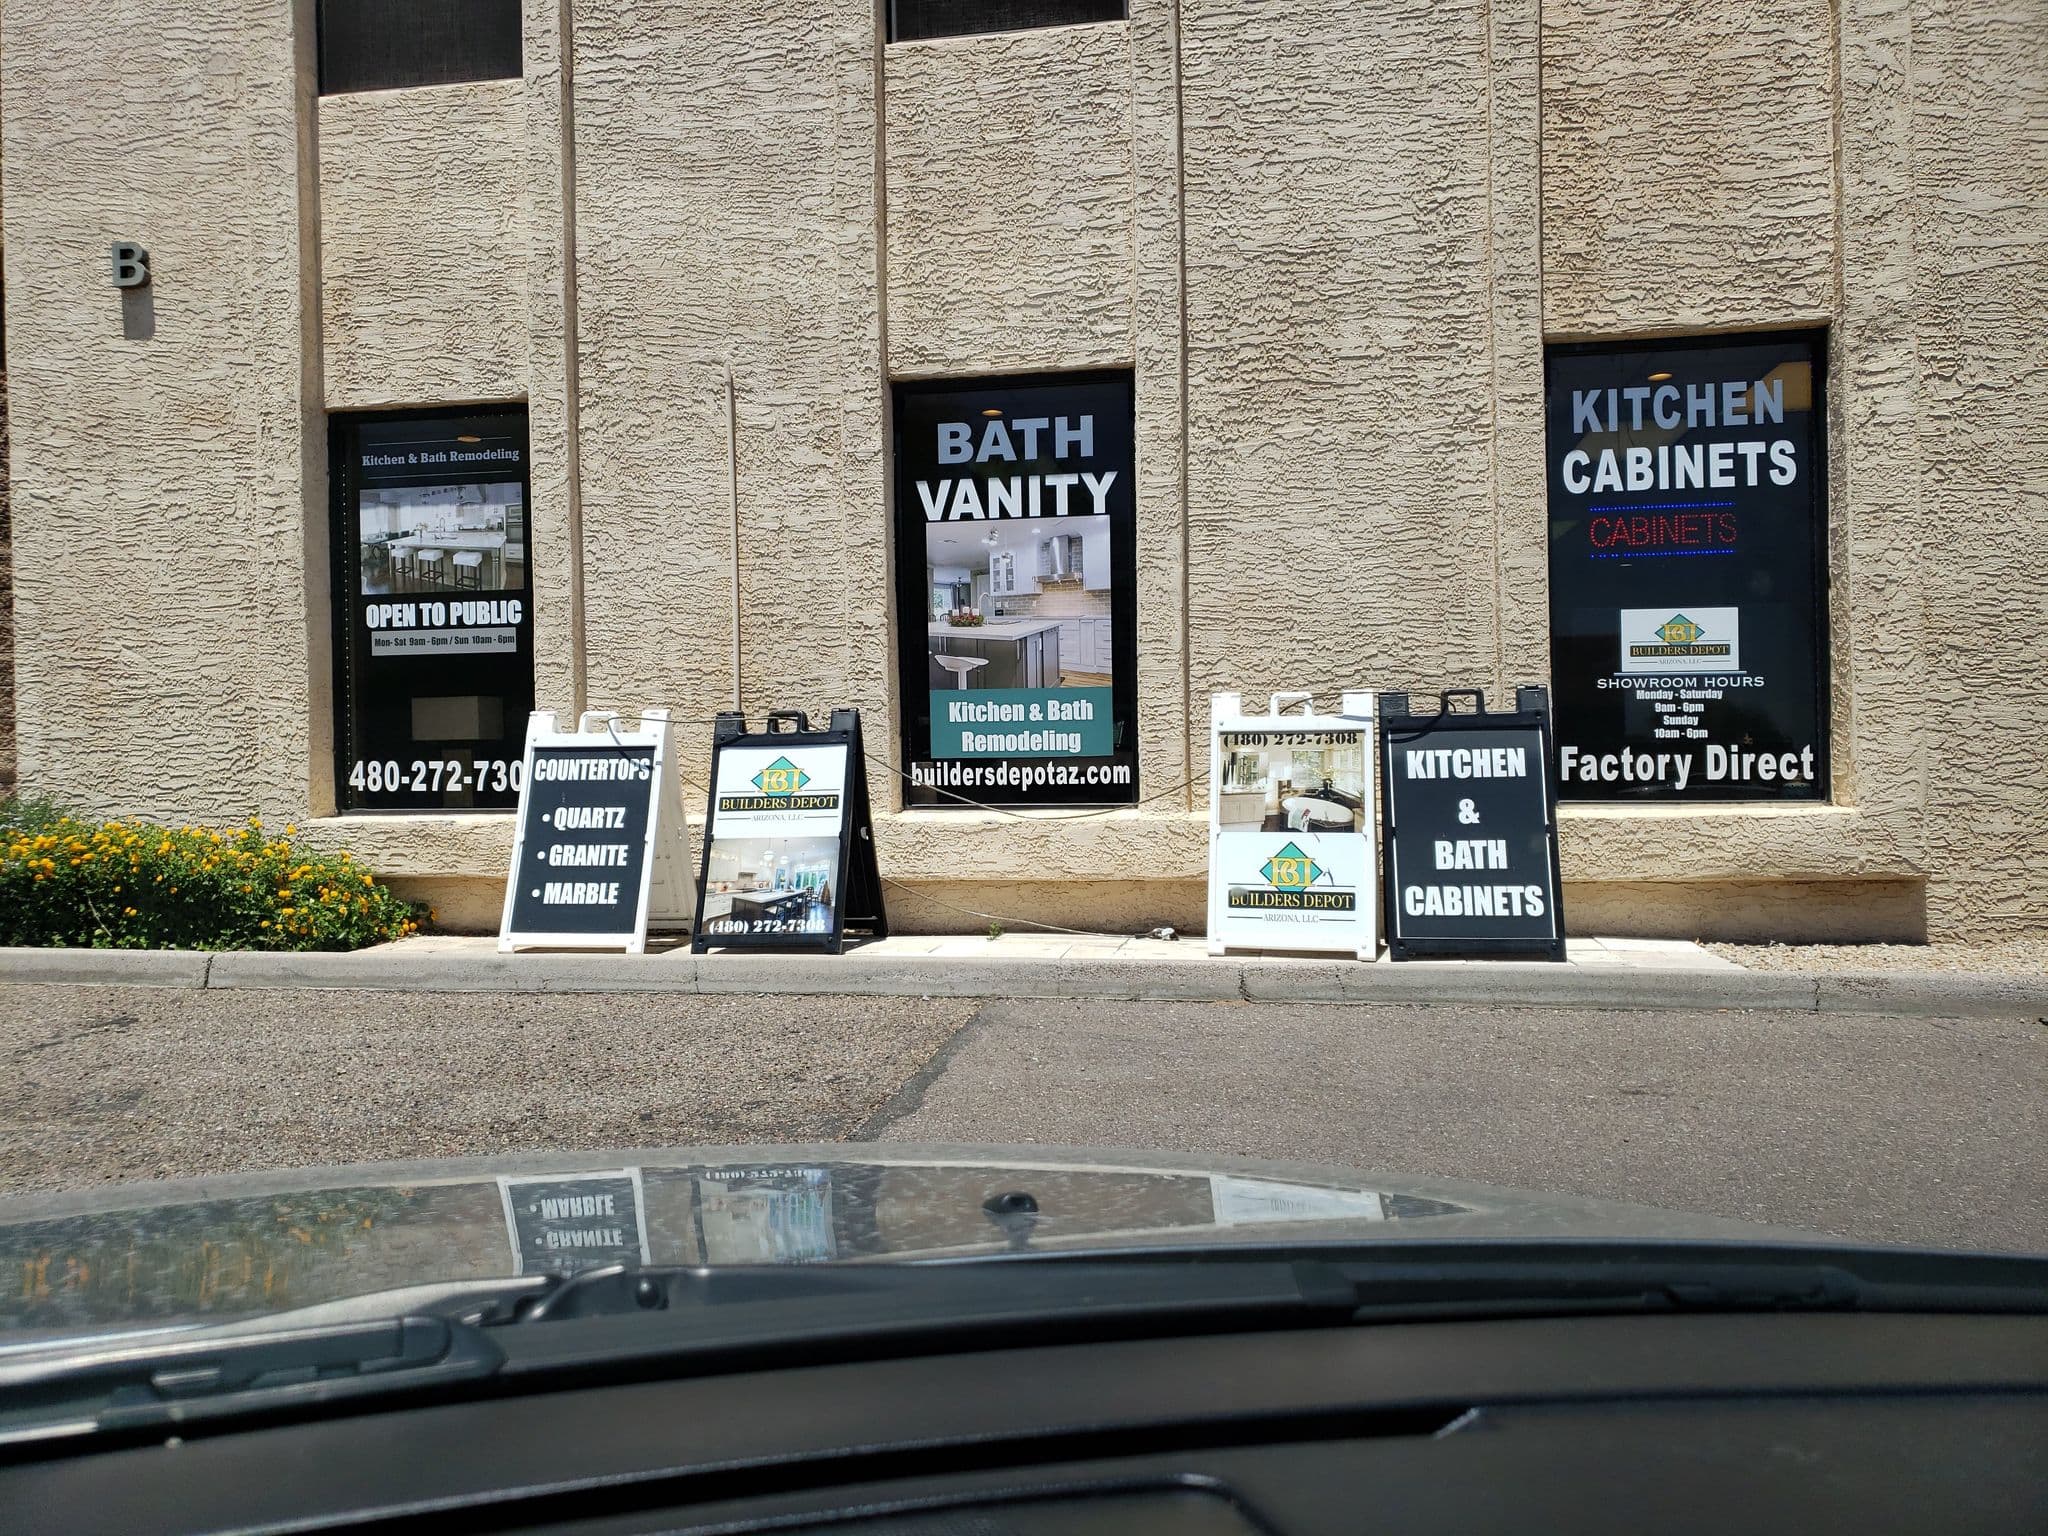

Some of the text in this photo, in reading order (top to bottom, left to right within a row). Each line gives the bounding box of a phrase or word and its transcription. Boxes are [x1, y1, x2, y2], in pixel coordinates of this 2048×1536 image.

[112, 241, 146, 287] B
[1572, 379, 1784, 434] KITCHEN
[937, 414, 1094, 465] BATH
[362, 449, 520, 467] Kitchen & Bath Remodeling
[1562, 440, 1797, 495] CABINETS
[915, 471, 1119, 521] VANITY
[1590, 513, 1737, 548] CABINETS
[366, 600, 522, 629] OPEN TO PUBLIC
[431, 636, 448, 647] 6pm
[454, 635, 469, 645] Sun
[472, 634, 492, 645] 10am
[498, 634, 515, 645] 6pm
[1632, 645, 1729, 656] BUILDERS DEPOT
[1597, 676, 1765, 689] SHOWROOM HOURS
[1636, 689, 1673, 700] Monday
[1680, 689, 1723, 700] Saturday
[949, 699, 1093, 723] Kitchen & Bath
[1655, 702, 1676, 712] 9am
[1683, 702, 1704, 713] 6pm
[1663, 715, 1699, 726] Sunday
[961, 730, 1081, 753] Remodeling
[1224, 732, 1358, 748] (480) 272-7308
[1654, 728, 1680, 739] 10am
[1686, 728, 1709, 739] 6pm
[534, 758, 650, 782] COUNTERTOPS
[1406, 748, 1527, 779] KITCHEN
[1561, 744, 1814, 790] Factory Direct
[911, 761, 1131, 791] buildersdepotaz.com
[721, 796, 838, 810] BUILDERS DEPOT
[1458, 798, 1480, 824] &
[554, 807, 627, 830] QUARTZ
[548, 844, 630, 867] GRANITE
[1434, 839, 1508, 870] BATH
[543, 882, 620, 905] MARBLE
[1303, 894, 1353, 909] DEPOT
[1404, 885, 1545, 917] CABINETS
[709, 920, 749, 935] (480)
